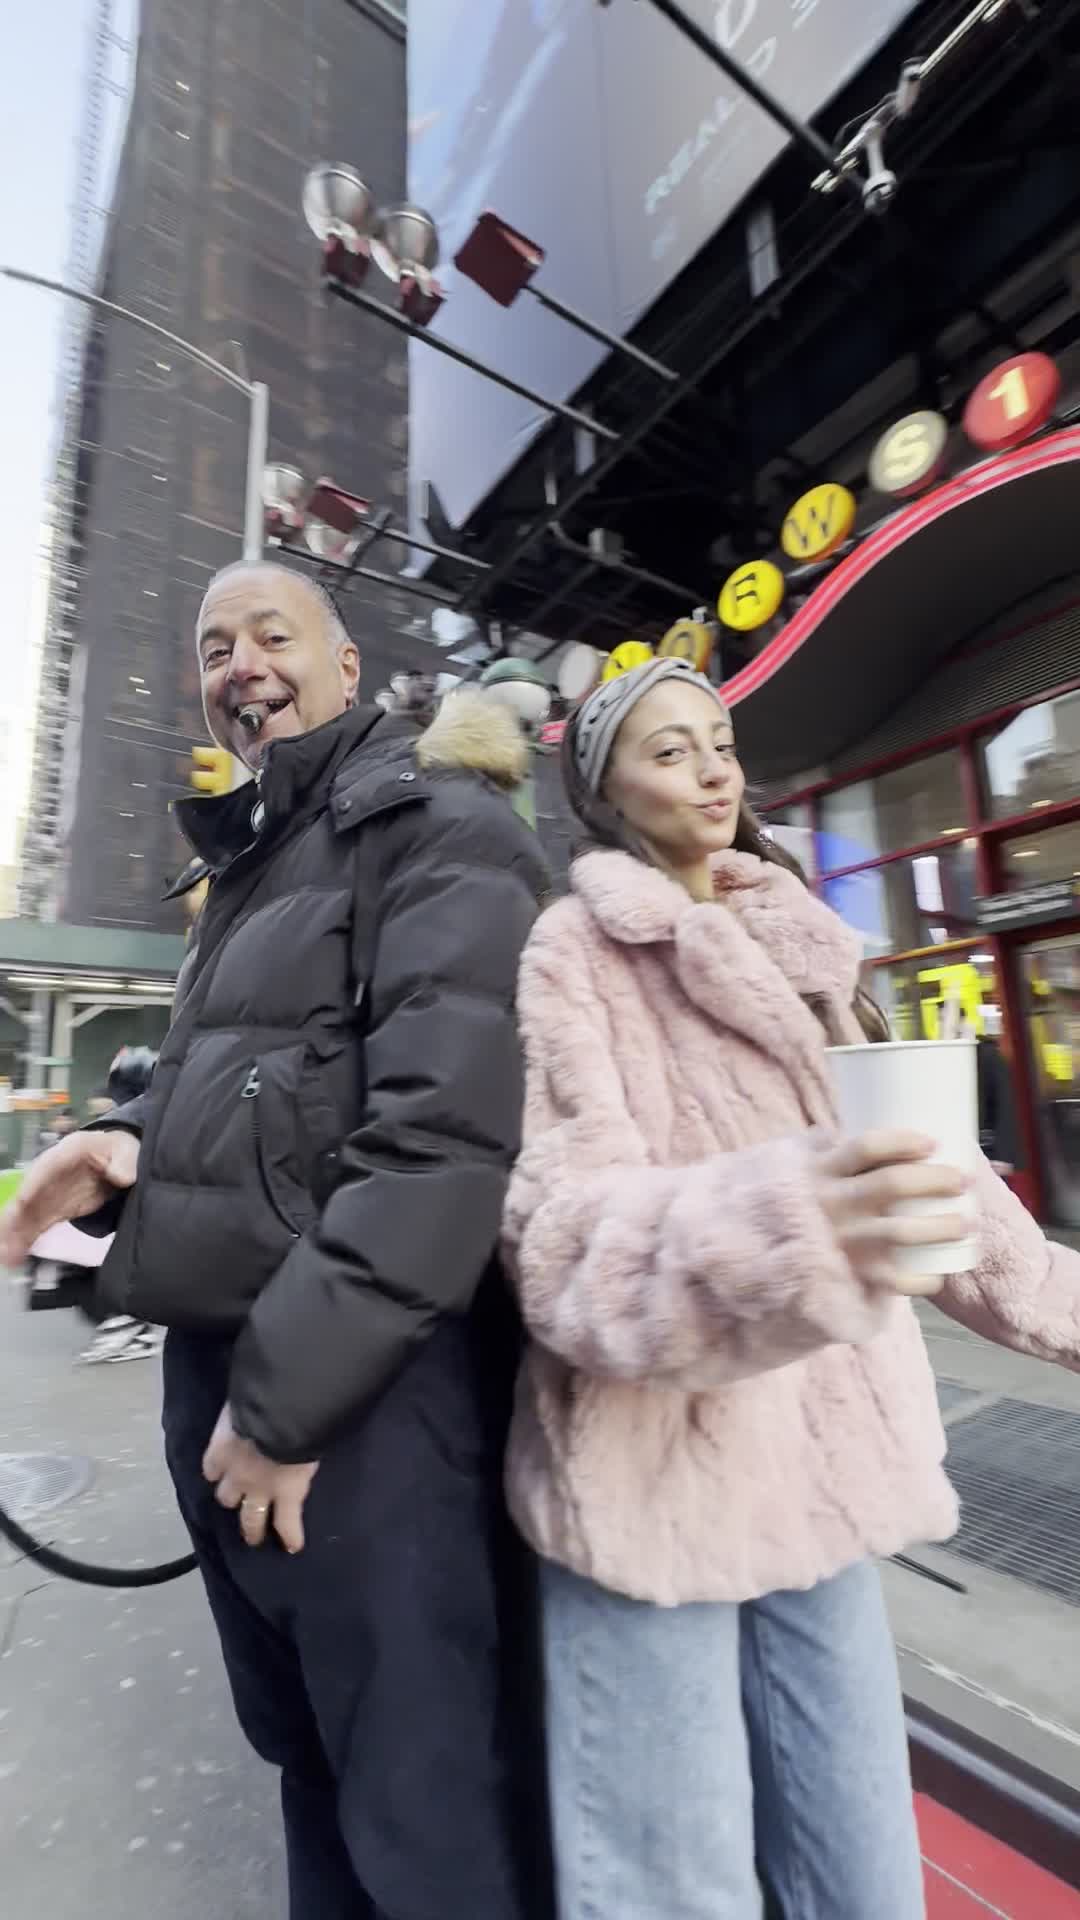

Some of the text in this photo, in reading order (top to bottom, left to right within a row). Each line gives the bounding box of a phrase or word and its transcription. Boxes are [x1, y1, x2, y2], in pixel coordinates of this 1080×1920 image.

[785, 492, 838, 549] W
[881, 423, 931, 479] S
[988, 365, 1029, 421] 1
